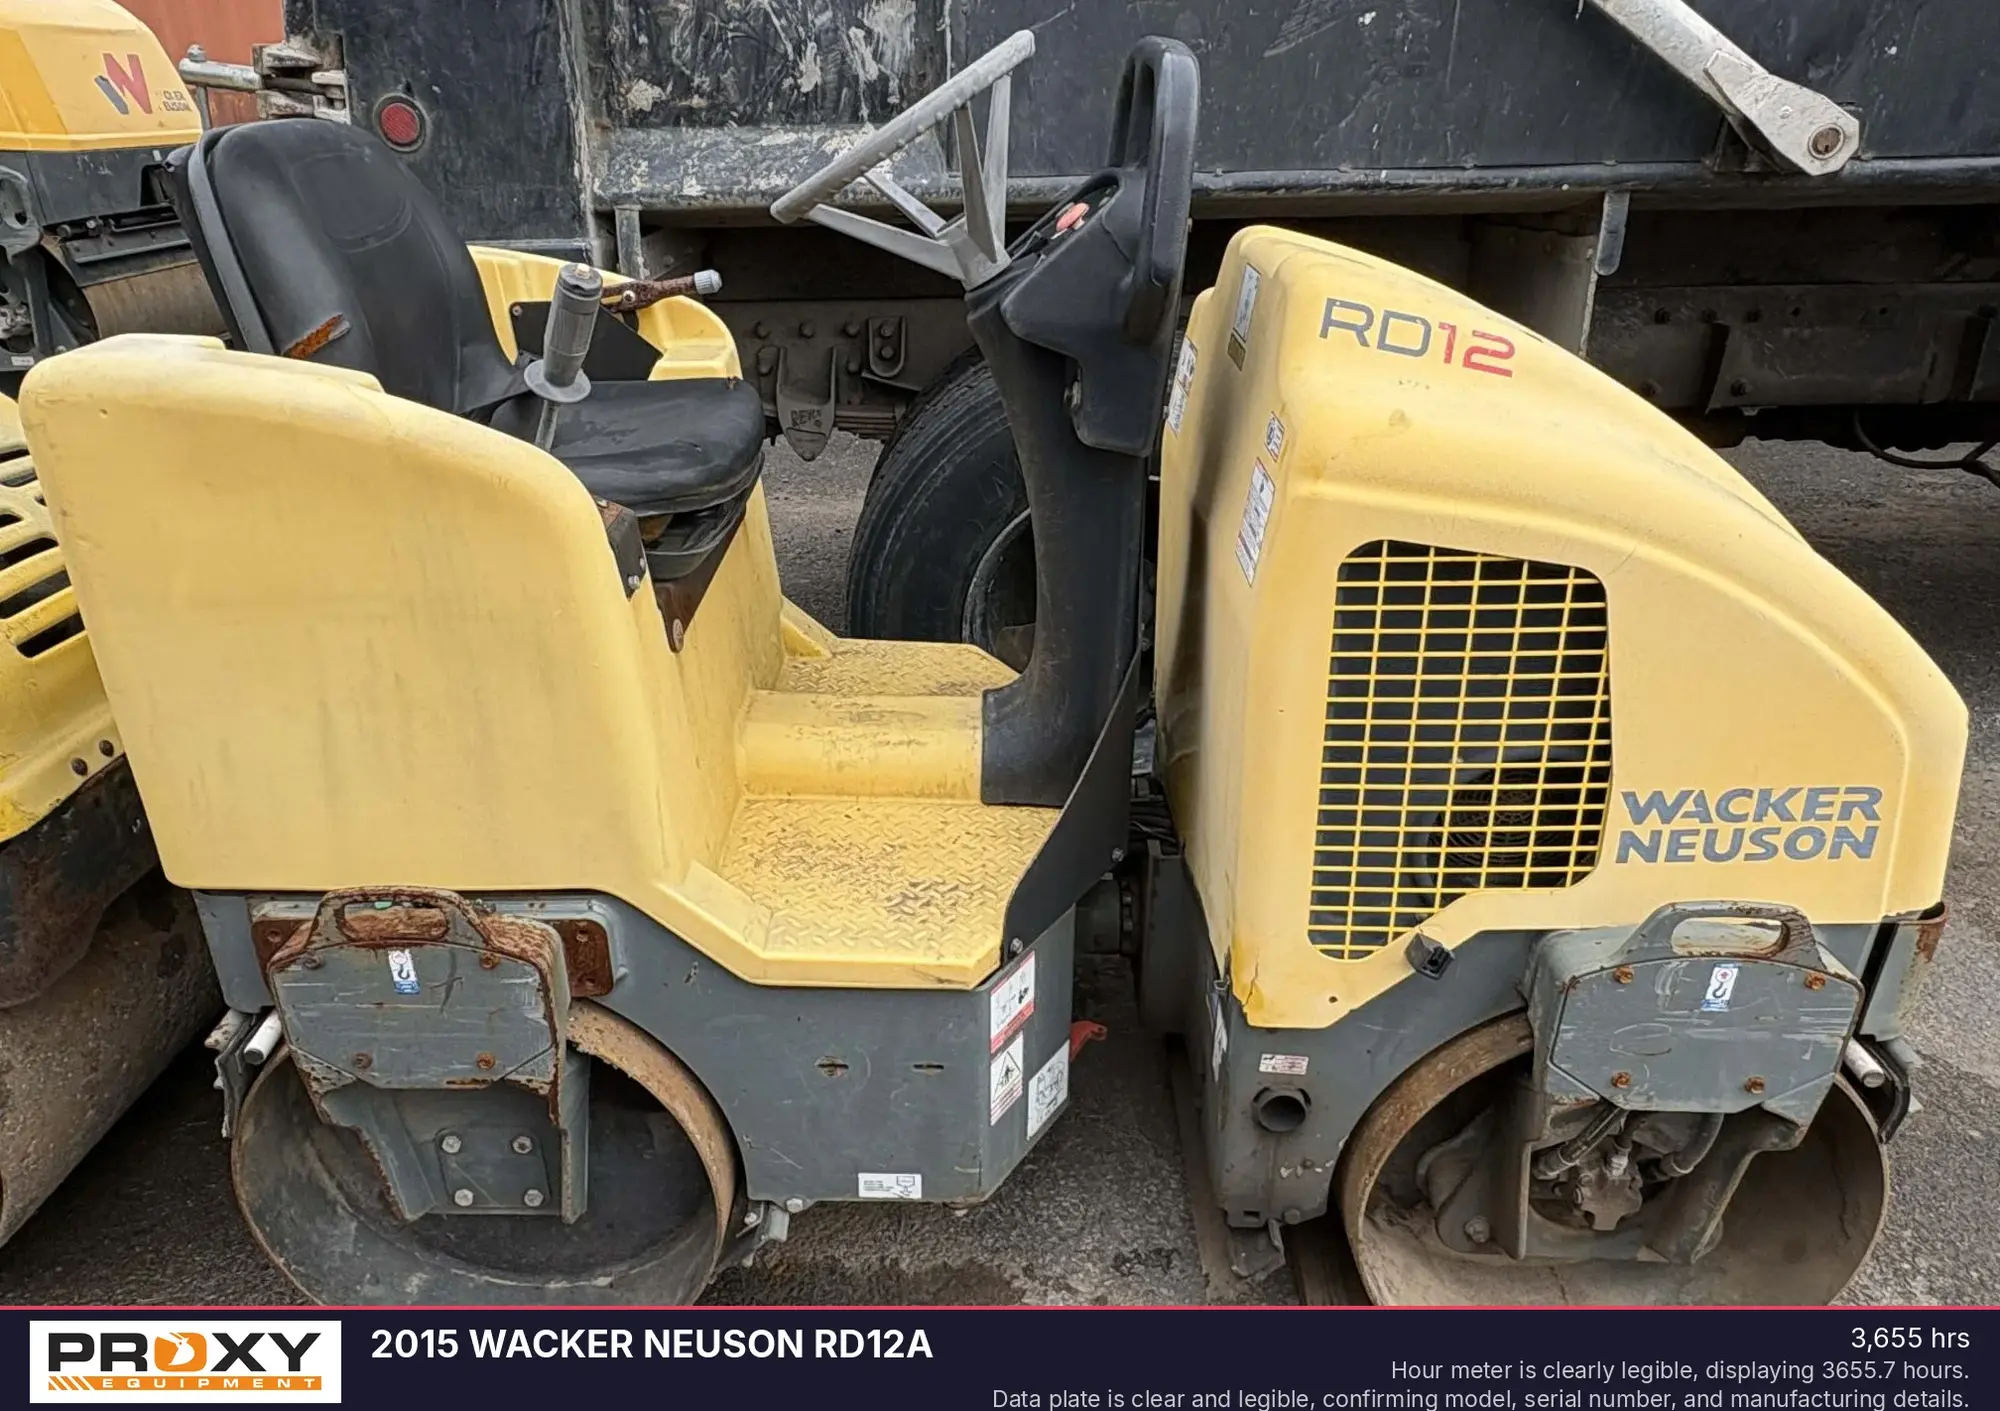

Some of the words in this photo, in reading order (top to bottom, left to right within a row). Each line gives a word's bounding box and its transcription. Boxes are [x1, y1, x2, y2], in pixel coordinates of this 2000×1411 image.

[1319, 297, 1516, 378] RD12
[1620, 786, 1884, 825] WACKER
[1615, 825, 1880, 864] NEUSON
